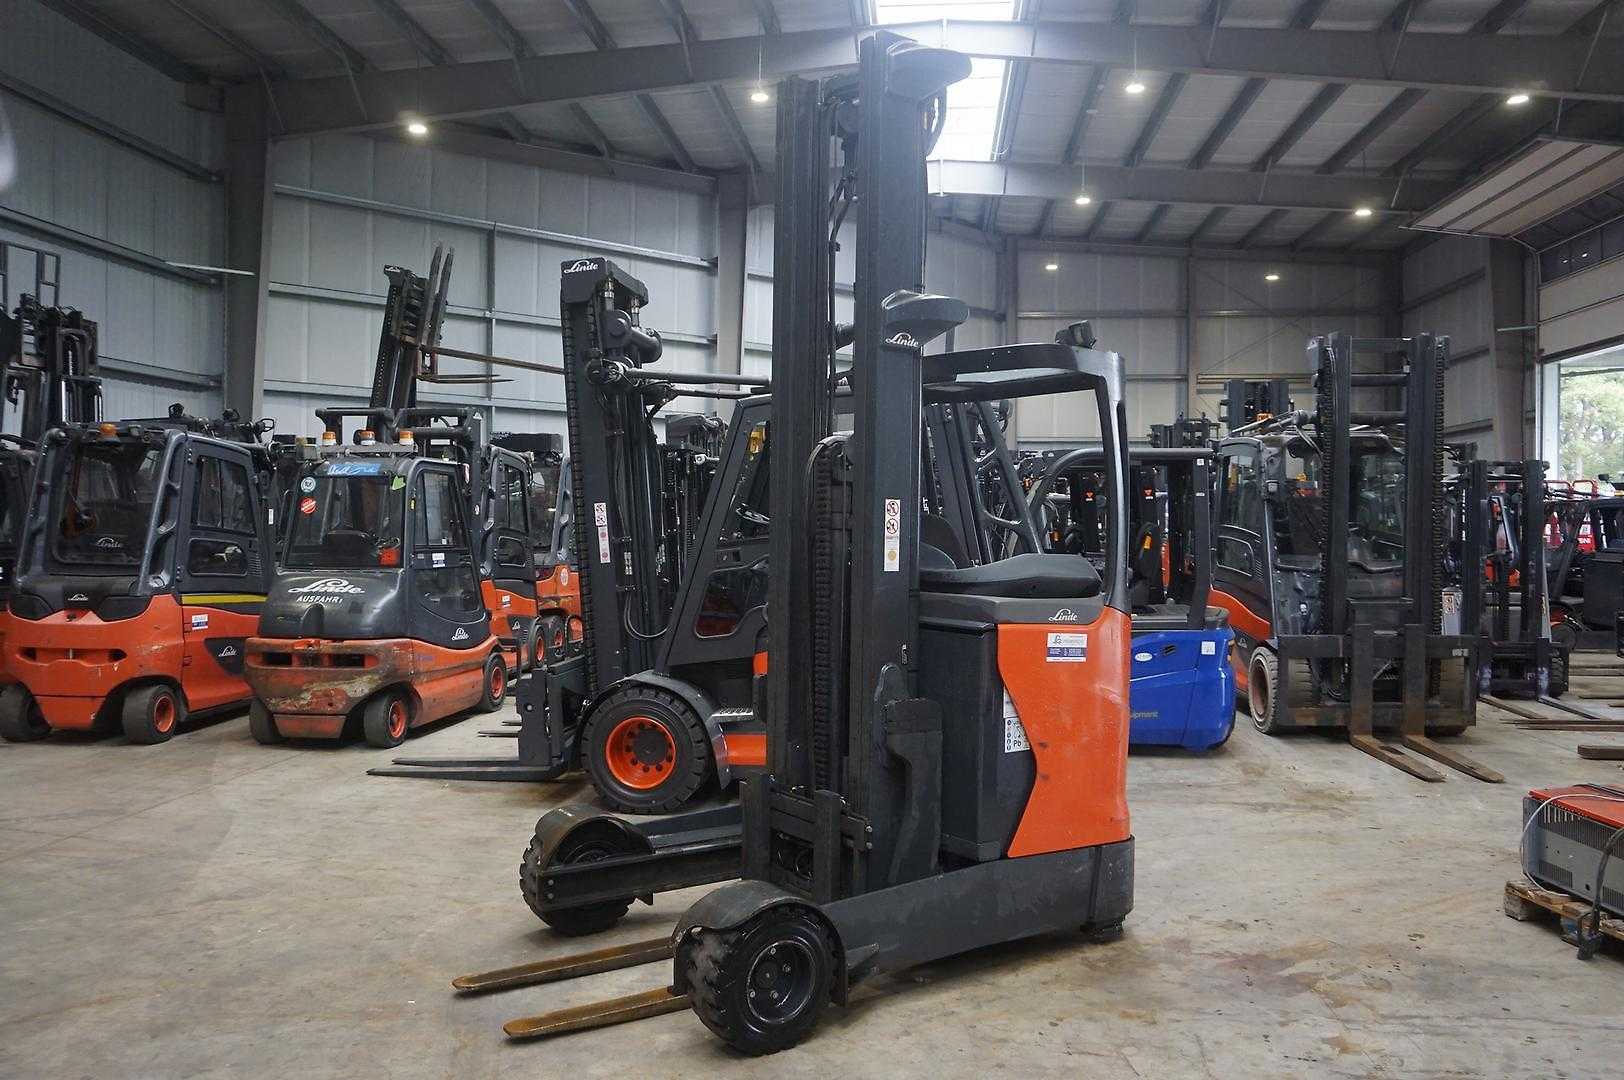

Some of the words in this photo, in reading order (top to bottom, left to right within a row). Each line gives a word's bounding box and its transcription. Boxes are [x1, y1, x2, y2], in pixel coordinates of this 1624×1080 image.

[563, 260, 598, 274] Linde
[885, 332, 919, 348] Linde
[287, 578, 365, 594] Linde
[1048, 608, 1078, 622] Linde
[1013, 739, 1022, 748] Pb
